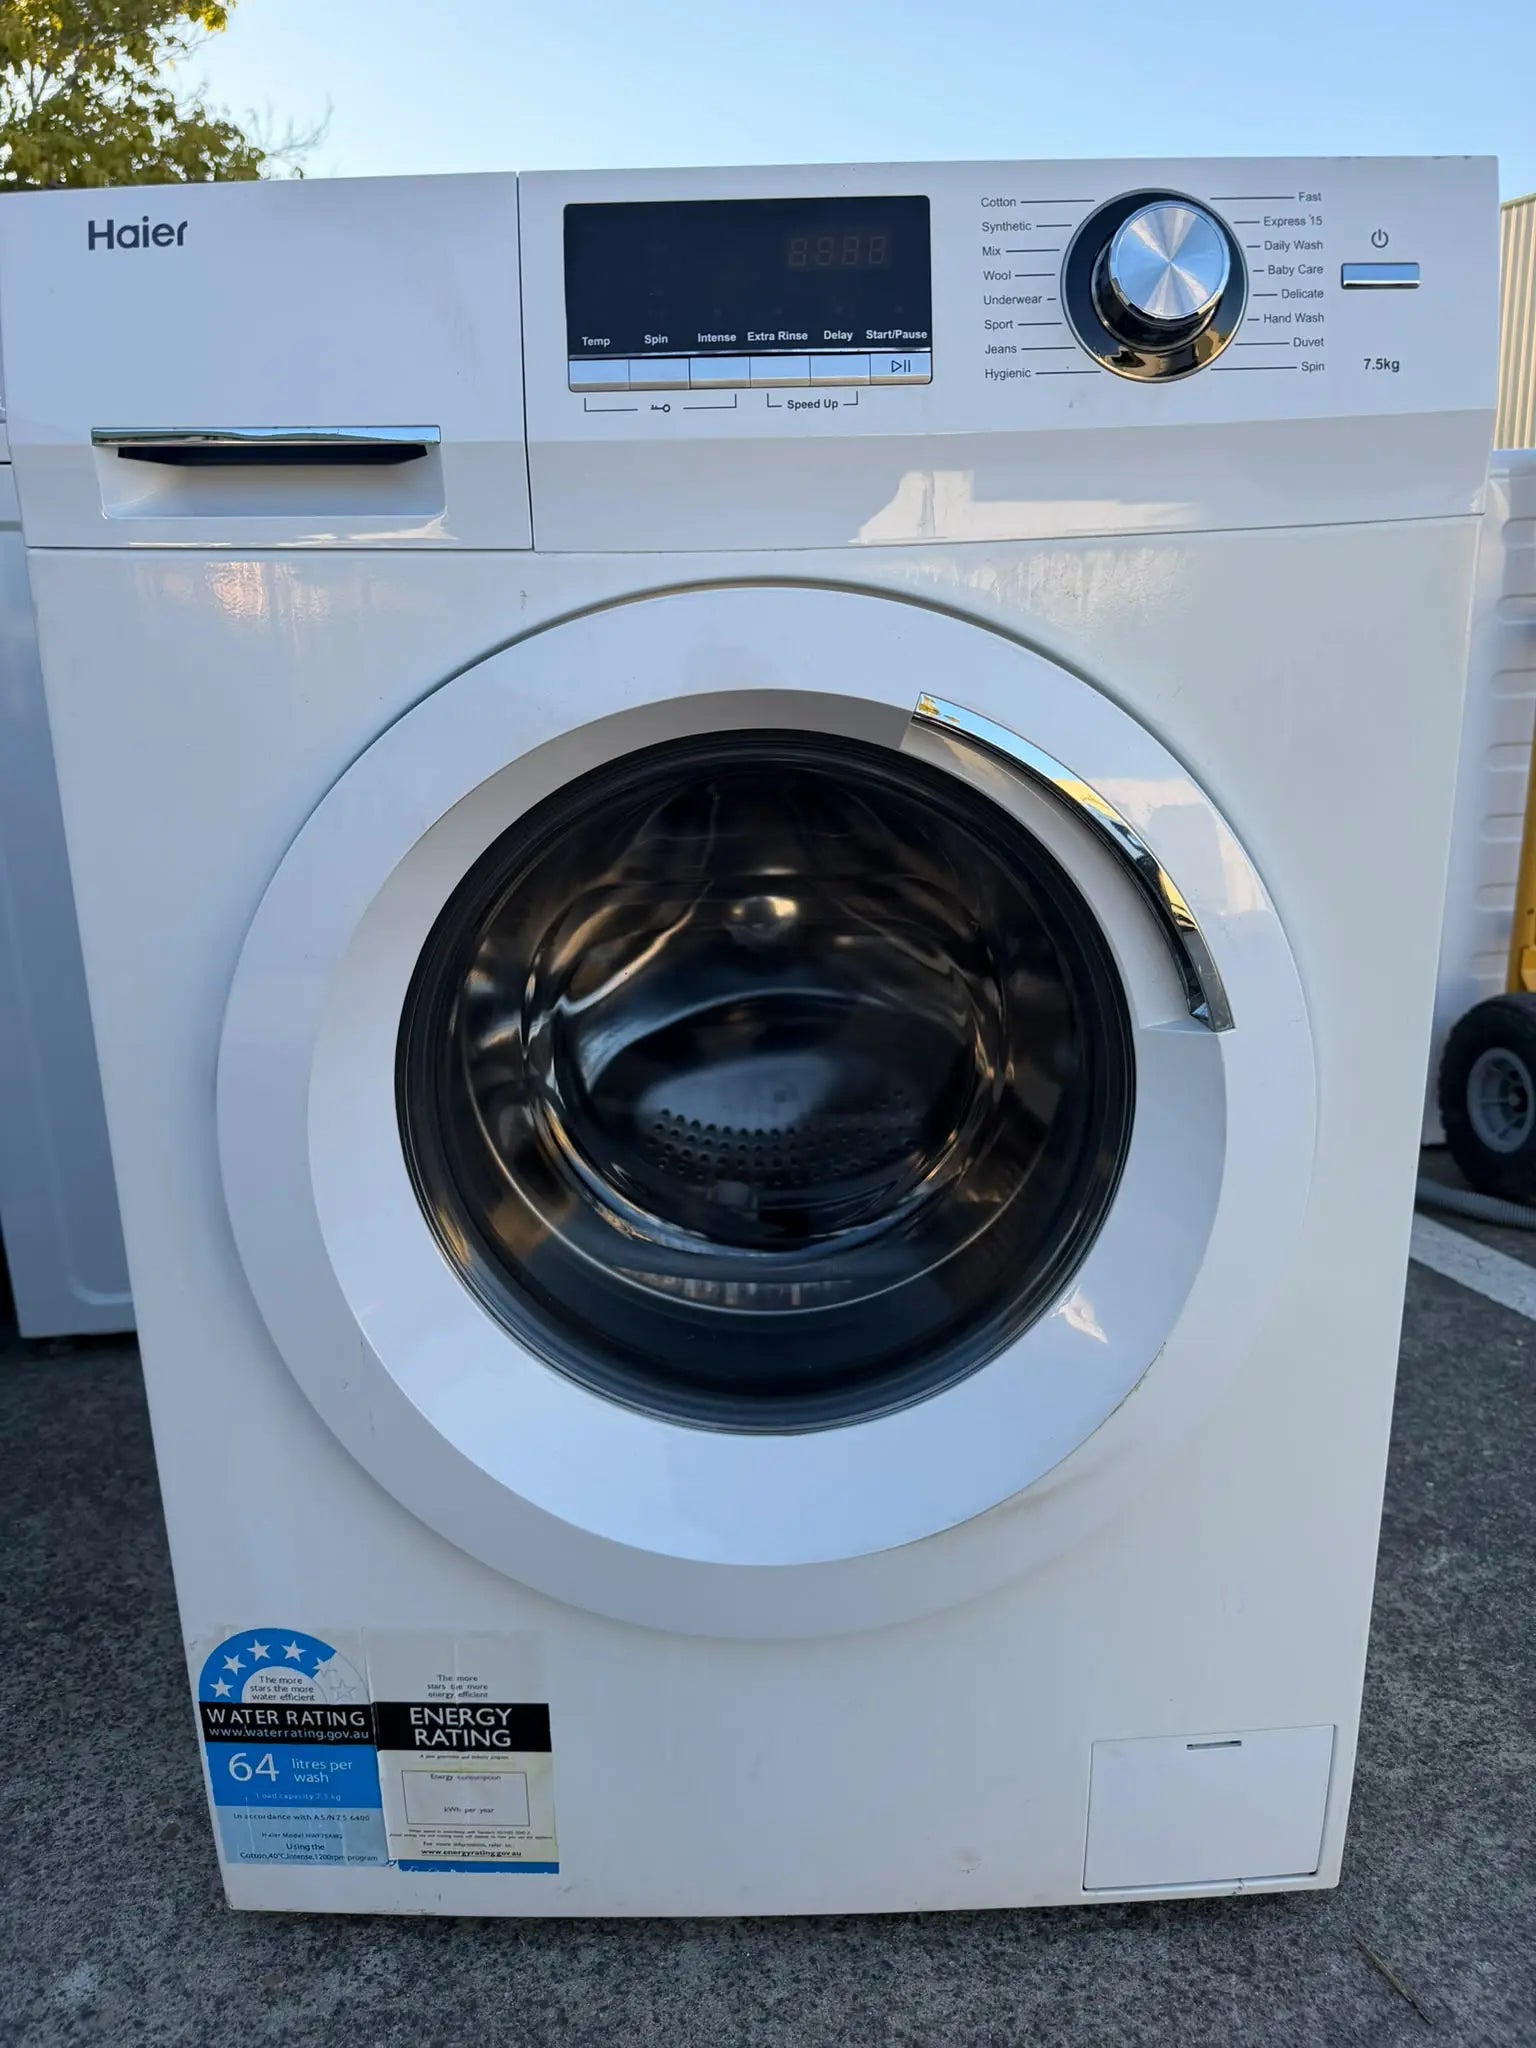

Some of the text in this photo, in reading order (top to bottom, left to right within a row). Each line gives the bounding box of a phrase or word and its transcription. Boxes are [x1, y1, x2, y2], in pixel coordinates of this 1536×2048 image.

[981, 196, 1017, 208] Cotton
[1298, 191, 1322, 203] Fast
[981, 220, 1032, 233] Synthetic
[1264, 216, 1306, 228] Express
[88, 216, 188, 250] Haier
[982, 246, 1001, 257] Mix
[1264, 240, 1323, 252] Daily Wash
[983, 270, 1011, 281] Wool
[1268, 264, 1324, 277] Baby Care
[983, 294, 1042, 306] Underwear
[1281, 288, 1324, 300] Delicate
[1264, 312, 1324, 324] Hand Wash
[984, 319, 1013, 332] Sport
[644, 333, 668, 346] Spin
[697, 332, 737, 342] Intense
[747, 331, 808, 341] Extra Rinse
[823, 330, 853, 342] Delay
[866, 329, 928, 341] Start/Pause
[582, 336, 610, 348] Temp
[1293, 337, 1324, 348] Duvet
[984, 343, 1017, 355] Jeans
[1301, 361, 1325, 374] Spin
[1363, 358, 1400, 372] 7.5kg
[984, 368, 1031, 381] Hygienic
[787, 398, 838, 412] Speed Up
[259, 1676, 276, 1684] The
[250, 1684, 271, 1692] stars
[280, 1693, 315, 1702] efficient
[207, 1709, 365, 1726] WATER RATING
[410, 1707, 512, 1726] ENERGY
[209, 1727, 369, 1741] www.waterrating.gov.au
[415, 1729, 511, 1747] RATING
[228, 1752, 280, 1782] 64
[292, 1758, 352, 1773] litres per
[294, 1772, 329, 1783] wash
[286, 1843, 310, 1851] Using
